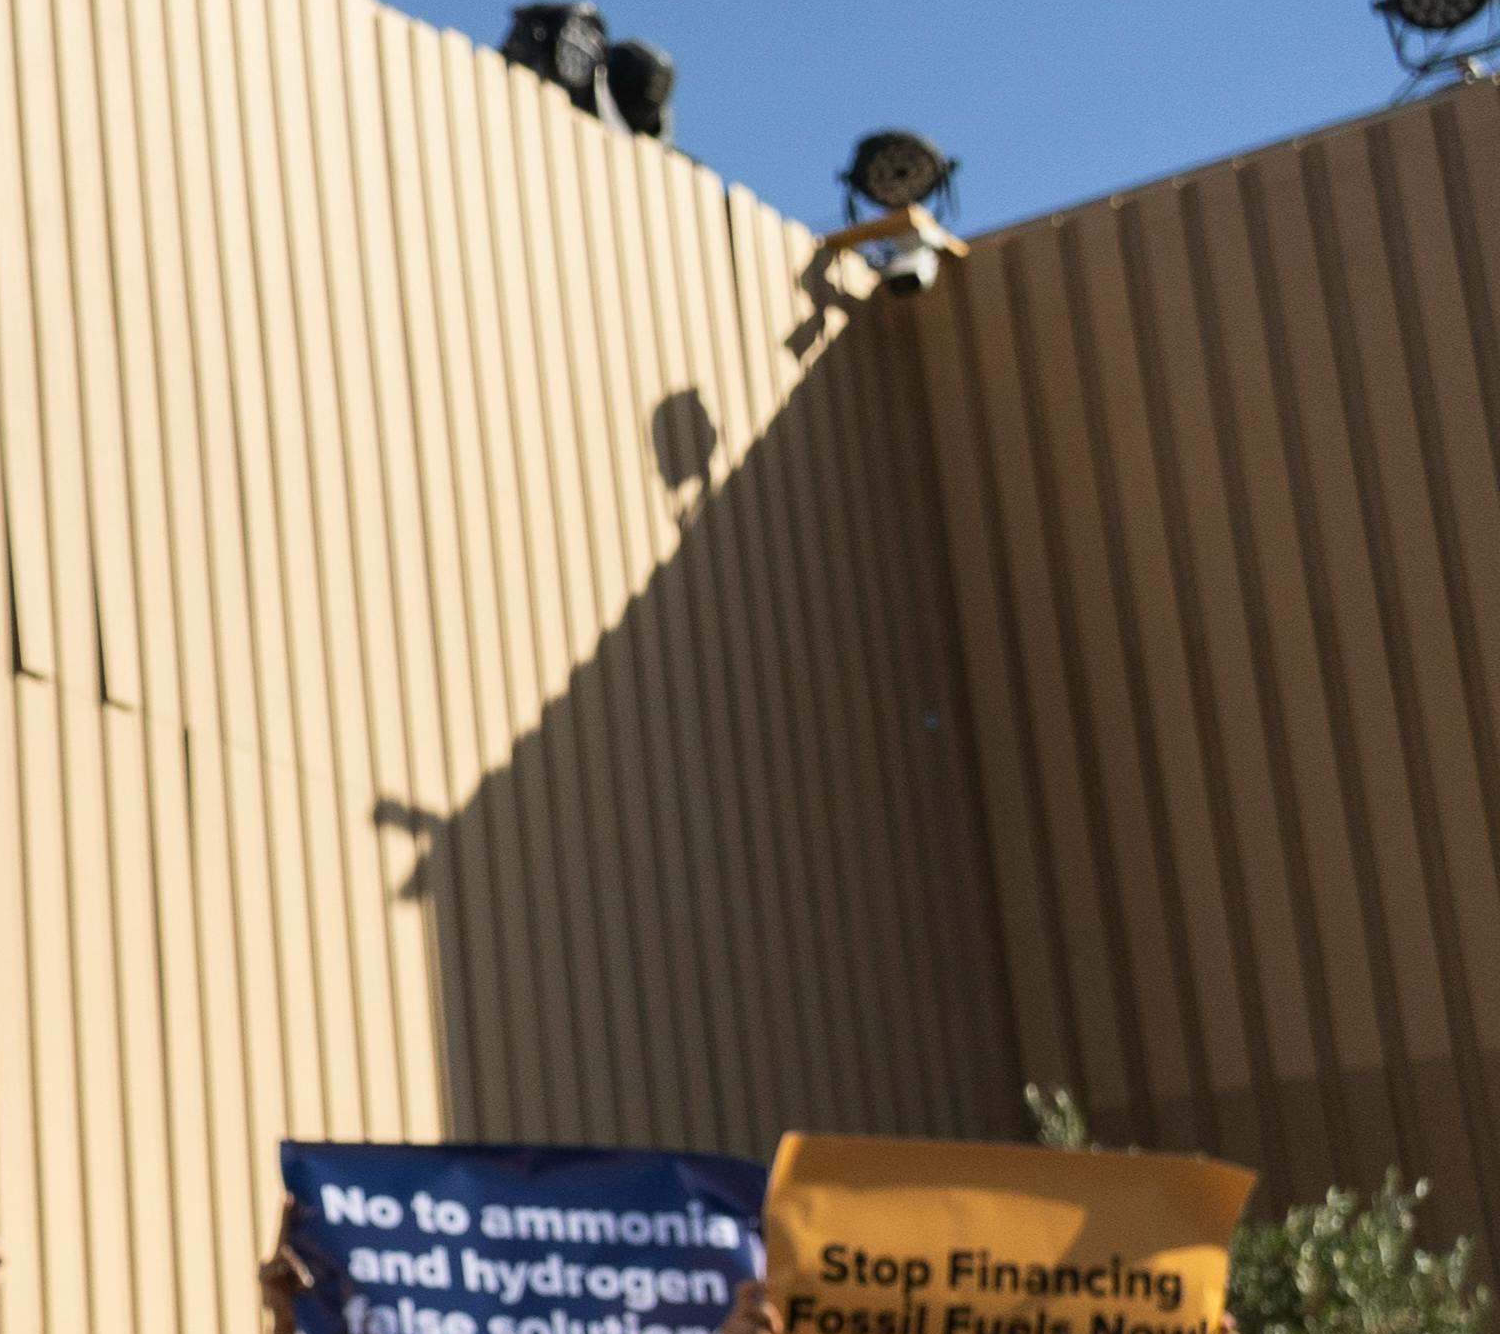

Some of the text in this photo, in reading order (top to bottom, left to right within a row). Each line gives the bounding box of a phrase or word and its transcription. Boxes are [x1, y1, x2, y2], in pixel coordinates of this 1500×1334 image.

[319, 1182, 740, 1251] No to ammonia
[347, 1244, 728, 1313] and hydrogen
[820, 1243, 1184, 1312] Stop Financing
